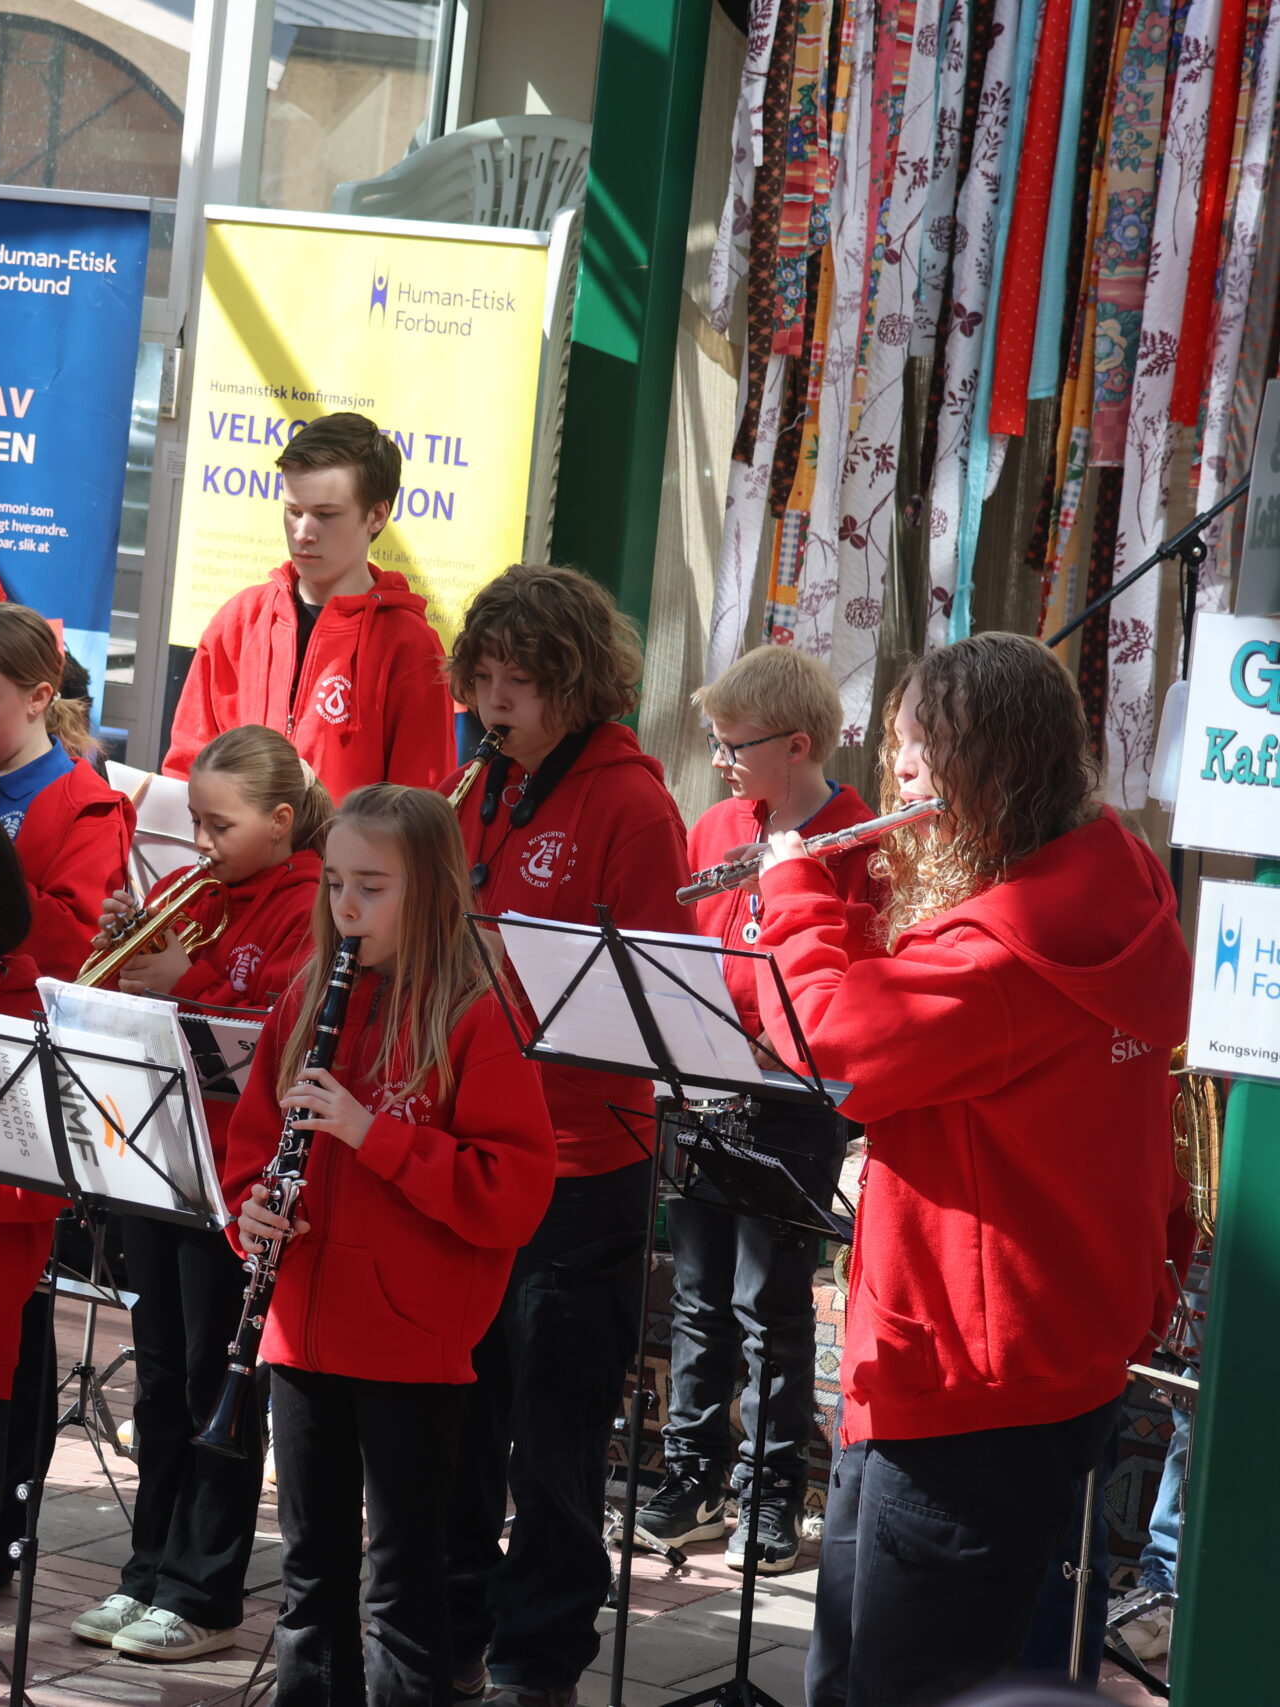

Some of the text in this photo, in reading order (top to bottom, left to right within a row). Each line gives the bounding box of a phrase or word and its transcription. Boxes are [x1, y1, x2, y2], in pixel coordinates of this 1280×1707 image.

[397, 282, 516, 313] Human-Etisk
[394, 310, 472, 337] Forbund
[209, 379, 375, 409] Humanistisk konfirmasjon
[425, 433, 469, 467] TIL
[30, 505, 54, 518] som
[11, 519, 69, 538] hverandre.
[18, 538, 37, 552] slik
[37, 540, 50, 554] at
[382, 550, 394, 563] til
[395, 551, 412, 565] alle
